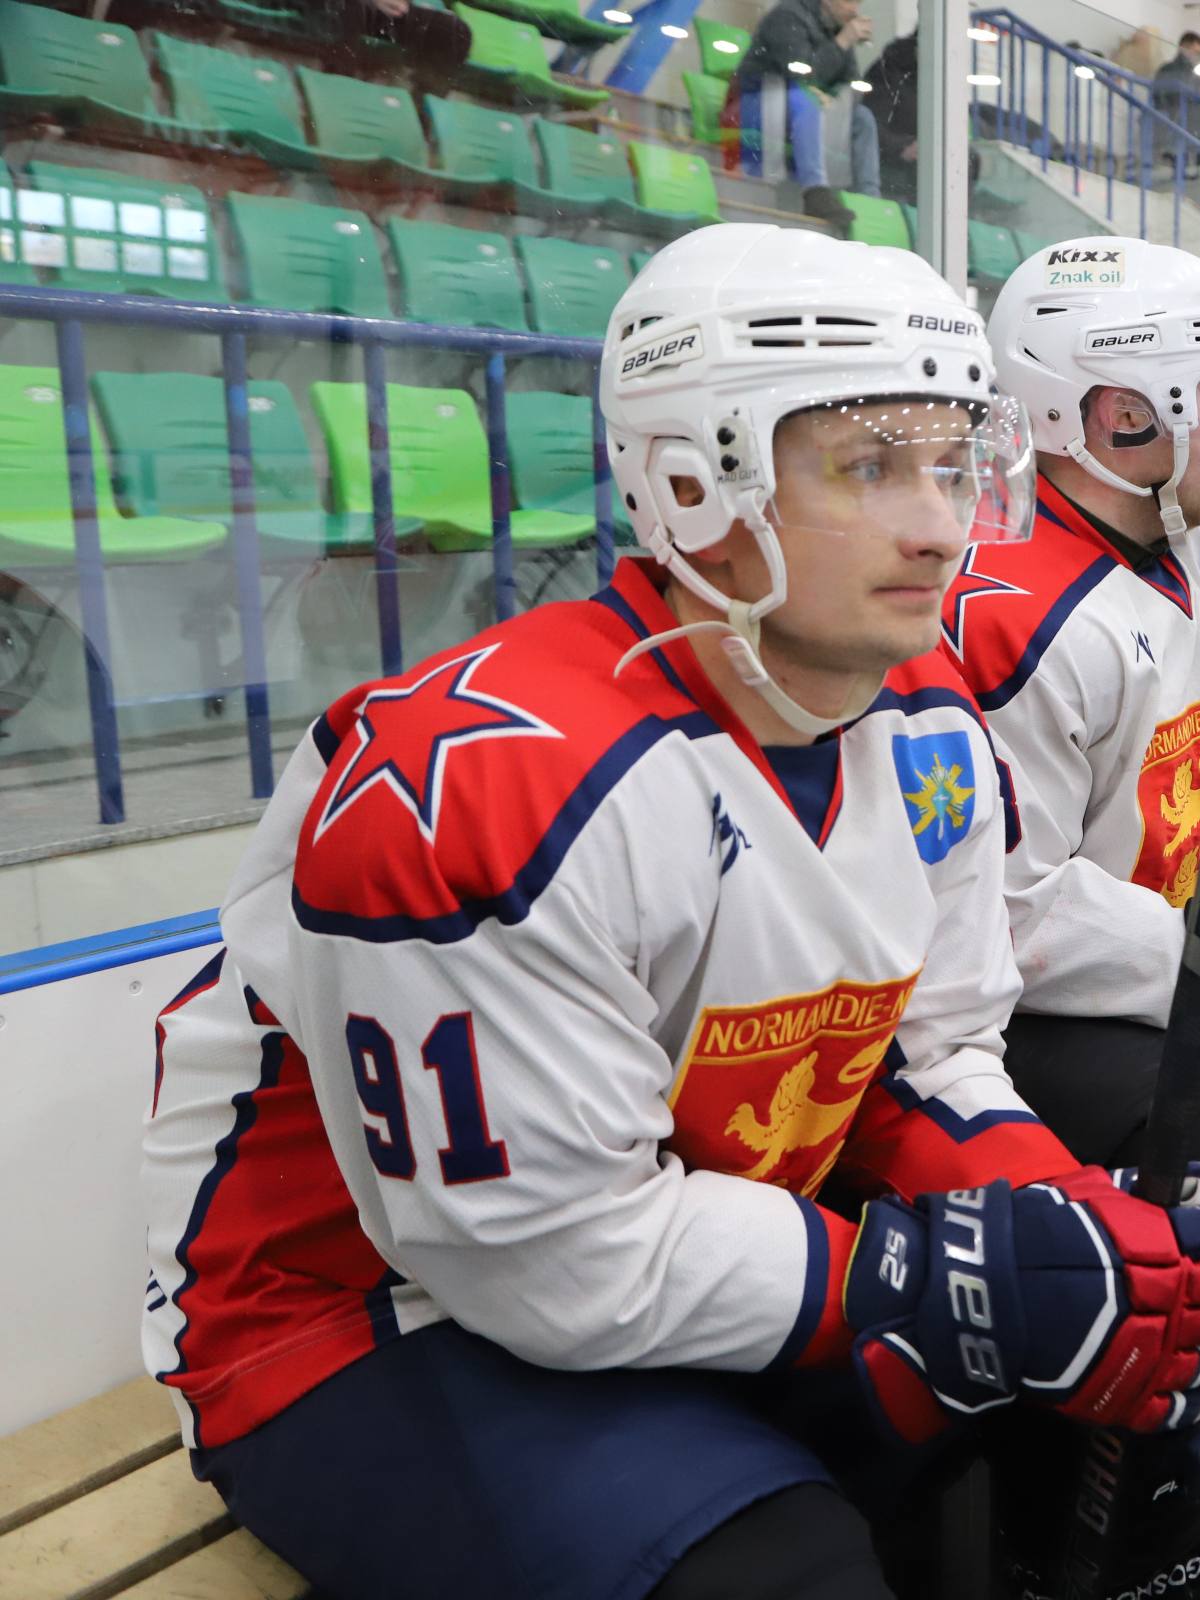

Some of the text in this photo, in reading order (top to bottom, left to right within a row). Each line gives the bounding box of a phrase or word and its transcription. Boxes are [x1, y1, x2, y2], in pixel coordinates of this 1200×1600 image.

[1050, 270, 1120, 285] Znak oil
[345, 1011, 511, 1186] 91
